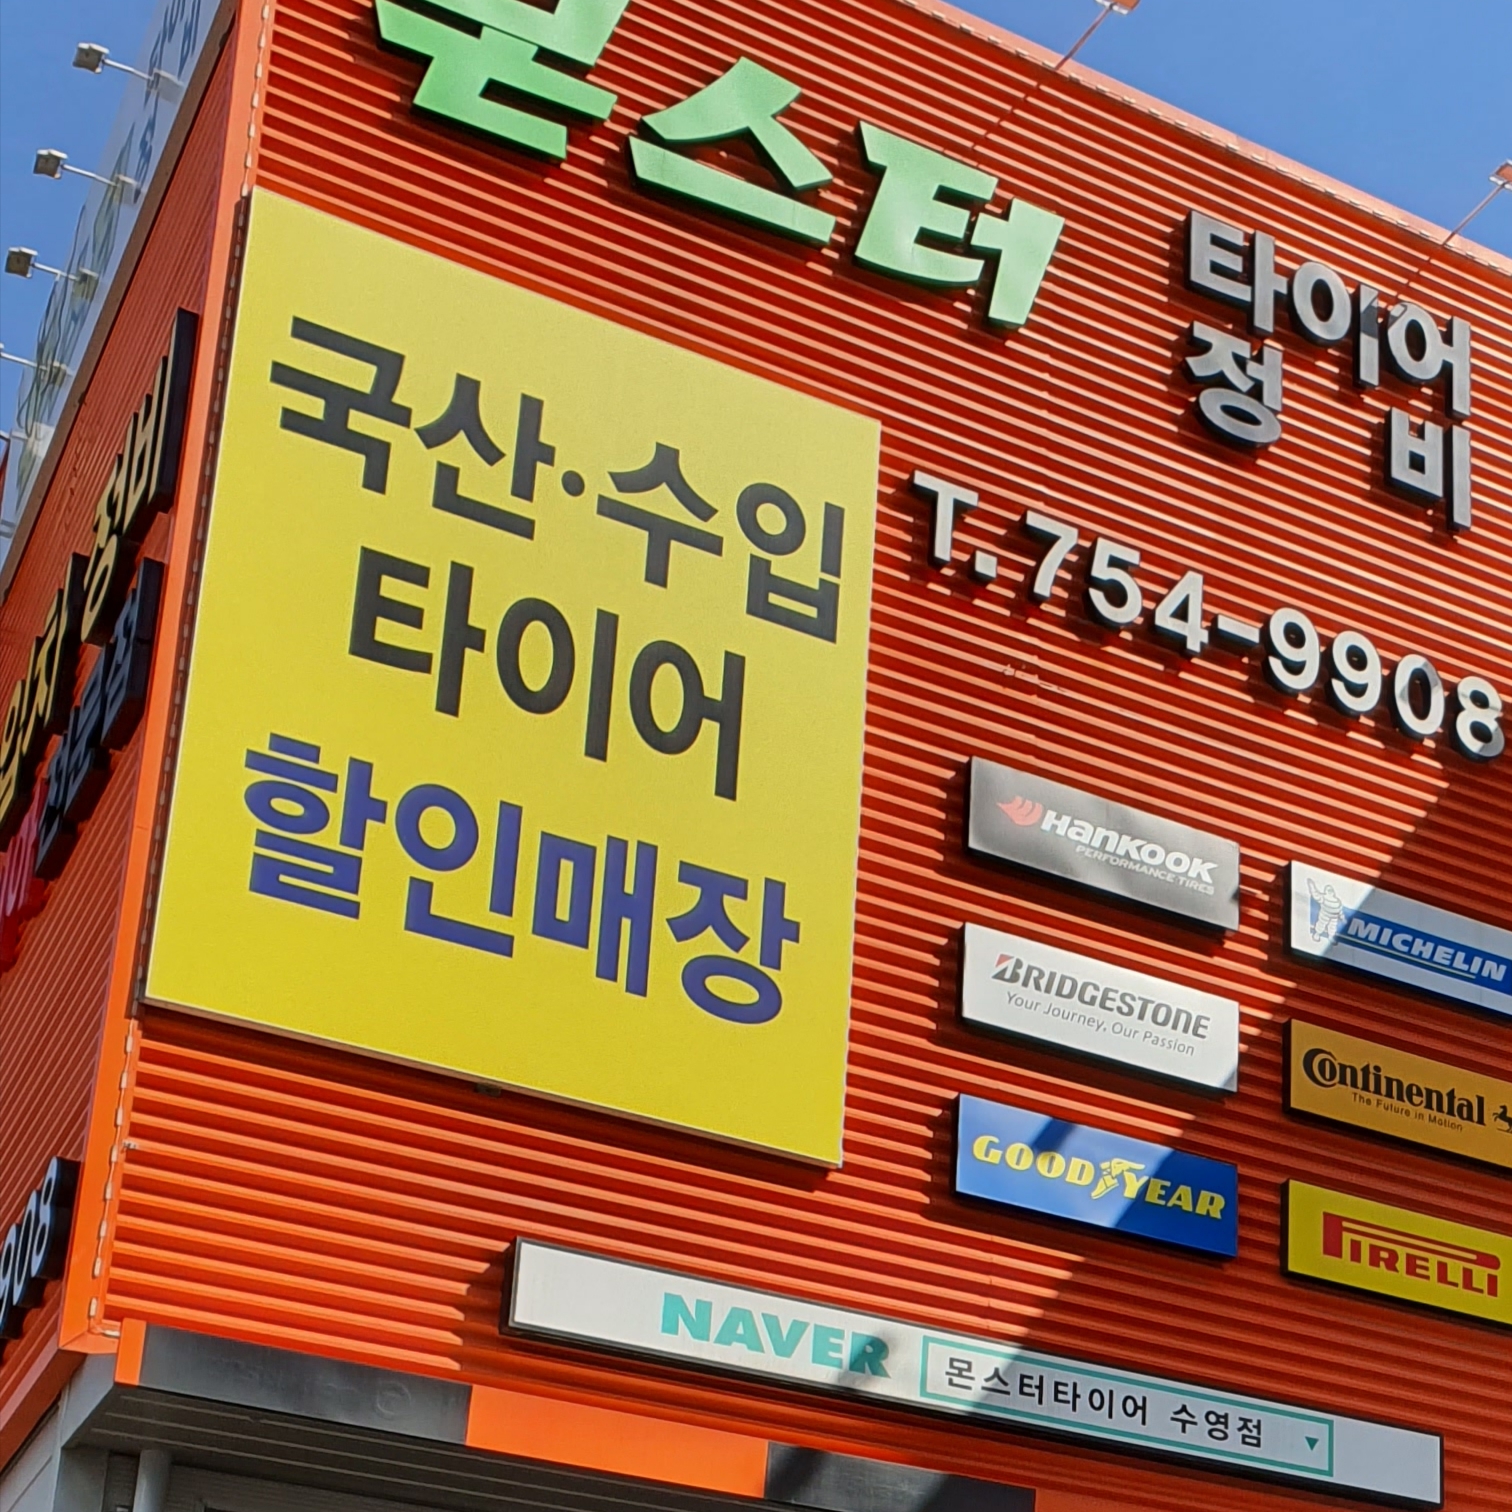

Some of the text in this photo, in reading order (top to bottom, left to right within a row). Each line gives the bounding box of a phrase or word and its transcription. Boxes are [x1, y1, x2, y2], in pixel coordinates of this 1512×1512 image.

[375, 0, 1064, 327] 몬스터
[1187, 210, 1472, 420] 타이어
[348, 546, 747, 802] 타이어
[244, 731, 801, 1025] 할인매장
[1075, 844, 1175, 884] PERFORMANCE
[1345, 917, 1508, 983] MICHELIN
[990, 952, 1213, 1041] BRIDGESTONE
[1005, 990, 1040, 1016] Your
[1111, 1020, 1140, 1042] Our
[1143, 1027, 1196, 1058] Passion
[1301, 1046, 1487, 1128] Continental
[1352, 1090, 1372, 1107] The
[1375, 1097, 1412, 1118] Future
[1429, 1112, 1464, 1133] Motion
[972, 1133, 1227, 1220] GOODYEAR
[1322, 1210, 1501, 1298] PIRELLI
[661, 1291, 891, 1380] NAVER
[944, 1355, 1264, 1450] 몬스터타이어 수영점
